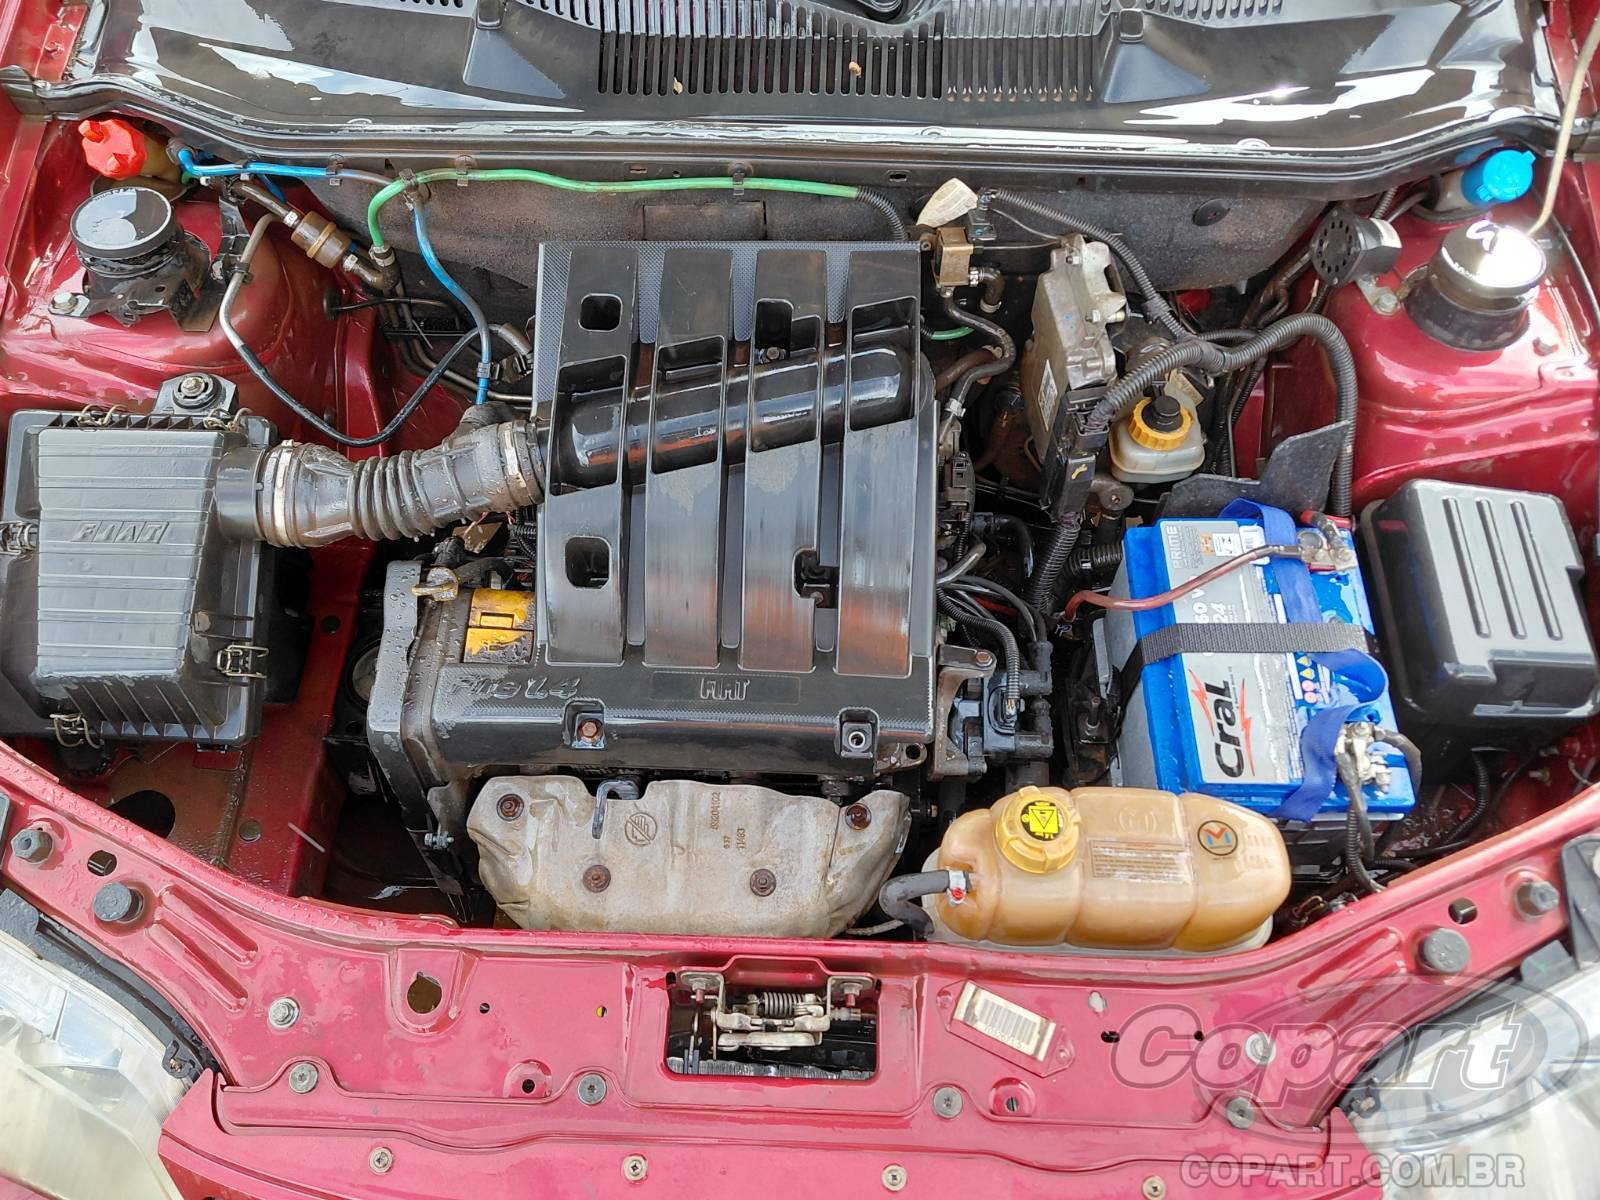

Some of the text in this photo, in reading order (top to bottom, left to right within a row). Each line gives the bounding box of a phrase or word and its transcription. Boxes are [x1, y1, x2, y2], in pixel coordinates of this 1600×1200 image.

[73, 523, 165, 543] FIAT
[1167, 525, 1183, 569] PRIME
[700, 677, 751, 701] FIAT
[1203, 679, 1245, 778] Cral
